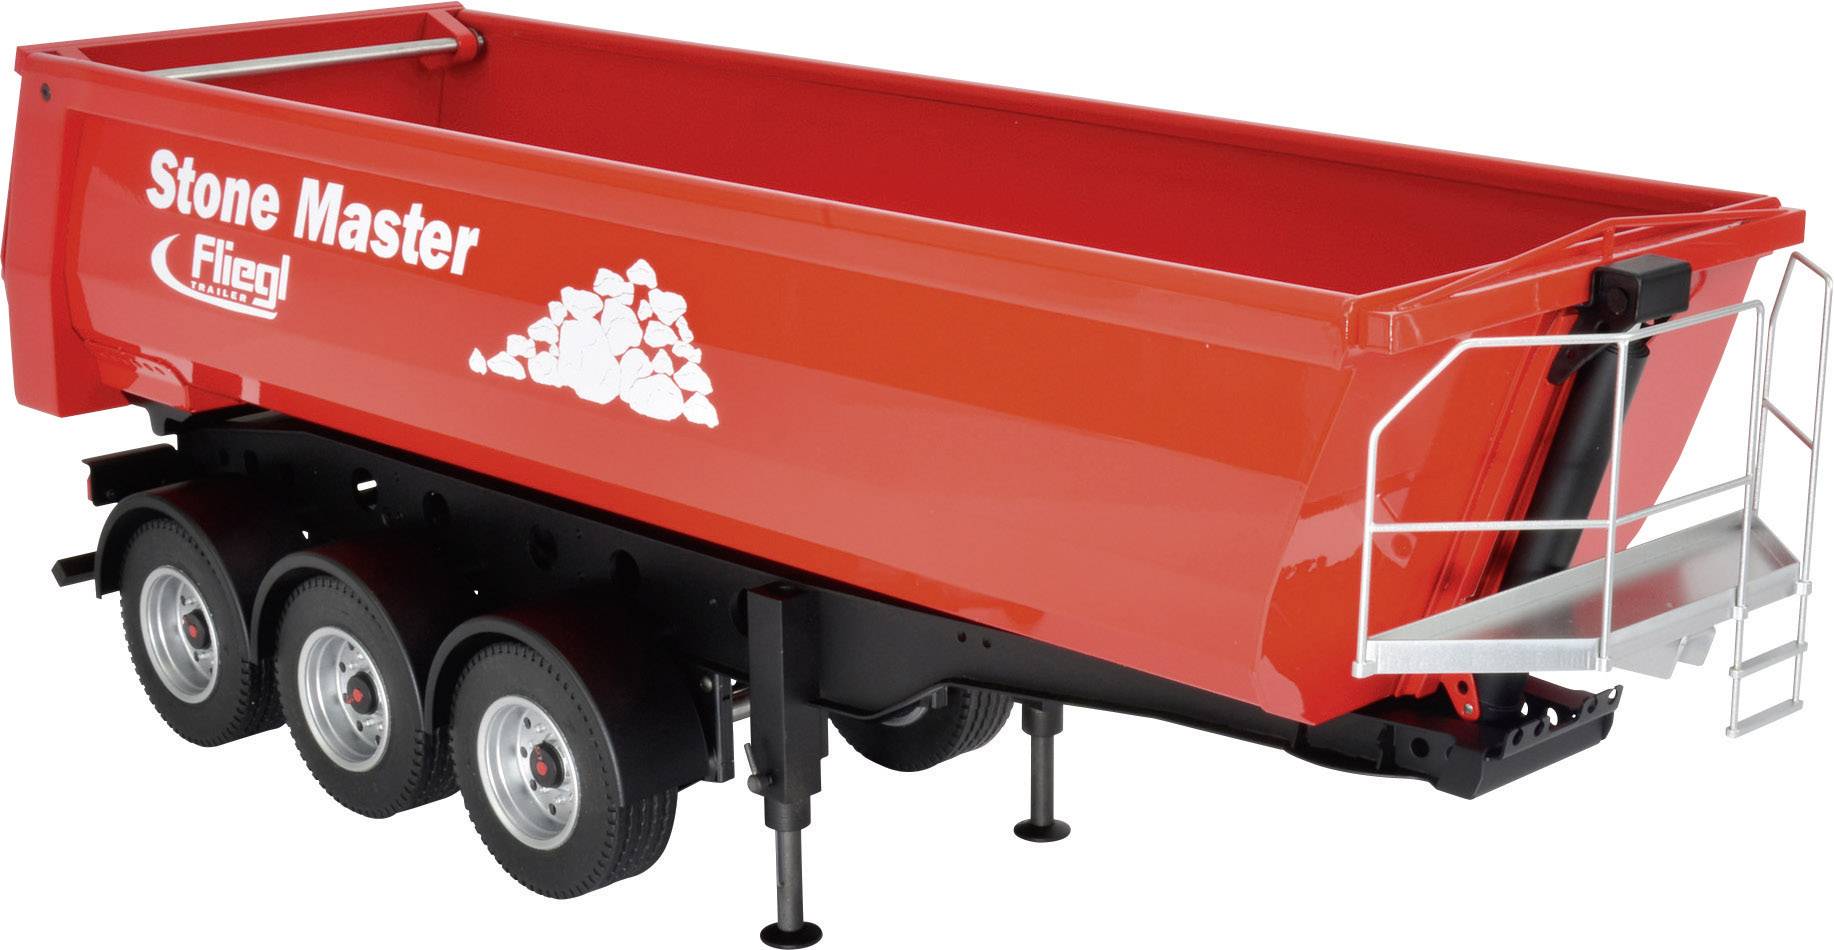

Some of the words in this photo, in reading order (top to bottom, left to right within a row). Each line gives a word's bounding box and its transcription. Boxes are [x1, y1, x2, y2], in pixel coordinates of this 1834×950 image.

[145, 149, 280, 231] Stone
[293, 177, 480, 275] Master
[190, 280, 247, 303] TRAILER
[191, 233, 290, 310] Fliegl
